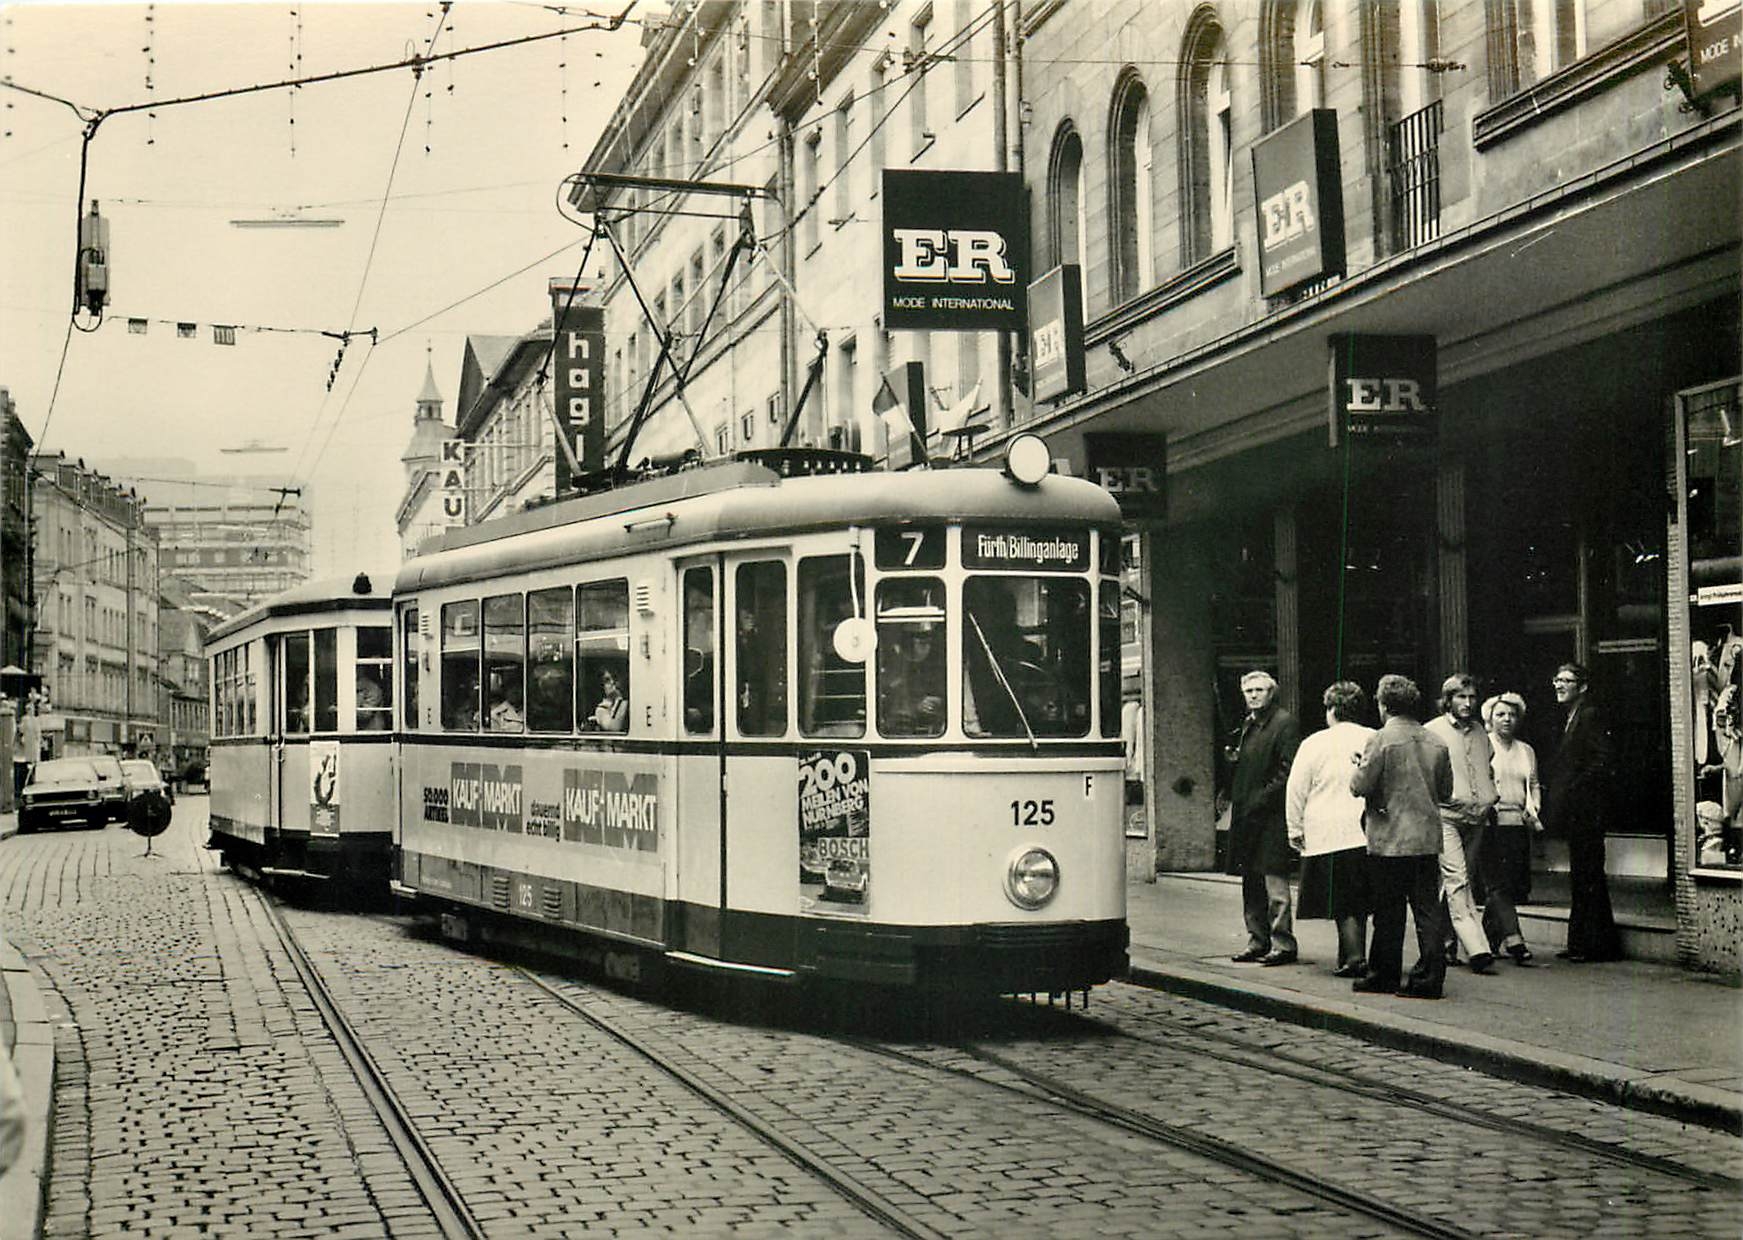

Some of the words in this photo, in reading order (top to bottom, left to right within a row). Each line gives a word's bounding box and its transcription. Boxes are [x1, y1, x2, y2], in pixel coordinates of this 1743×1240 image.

[1700, 38, 1728, 64] MODE
[1261, 180, 1314, 253] ER
[893, 228, 1015, 284] ER
[893, 297, 925, 308] MODE
[931, 298, 1015, 310] INTERNATIONAL
[1346, 378, 1428, 414] ER
[1097, 467, 1159, 493] ER
[901, 532, 924, 565] 7
[799, 752, 857, 800] 200
[1085, 775, 1093, 796] F
[801, 786, 842, 813] MEILEN
[841, 778, 869, 800] VON
[1011, 800, 1055, 826] 125
[818, 838, 869, 859] BOSCH
